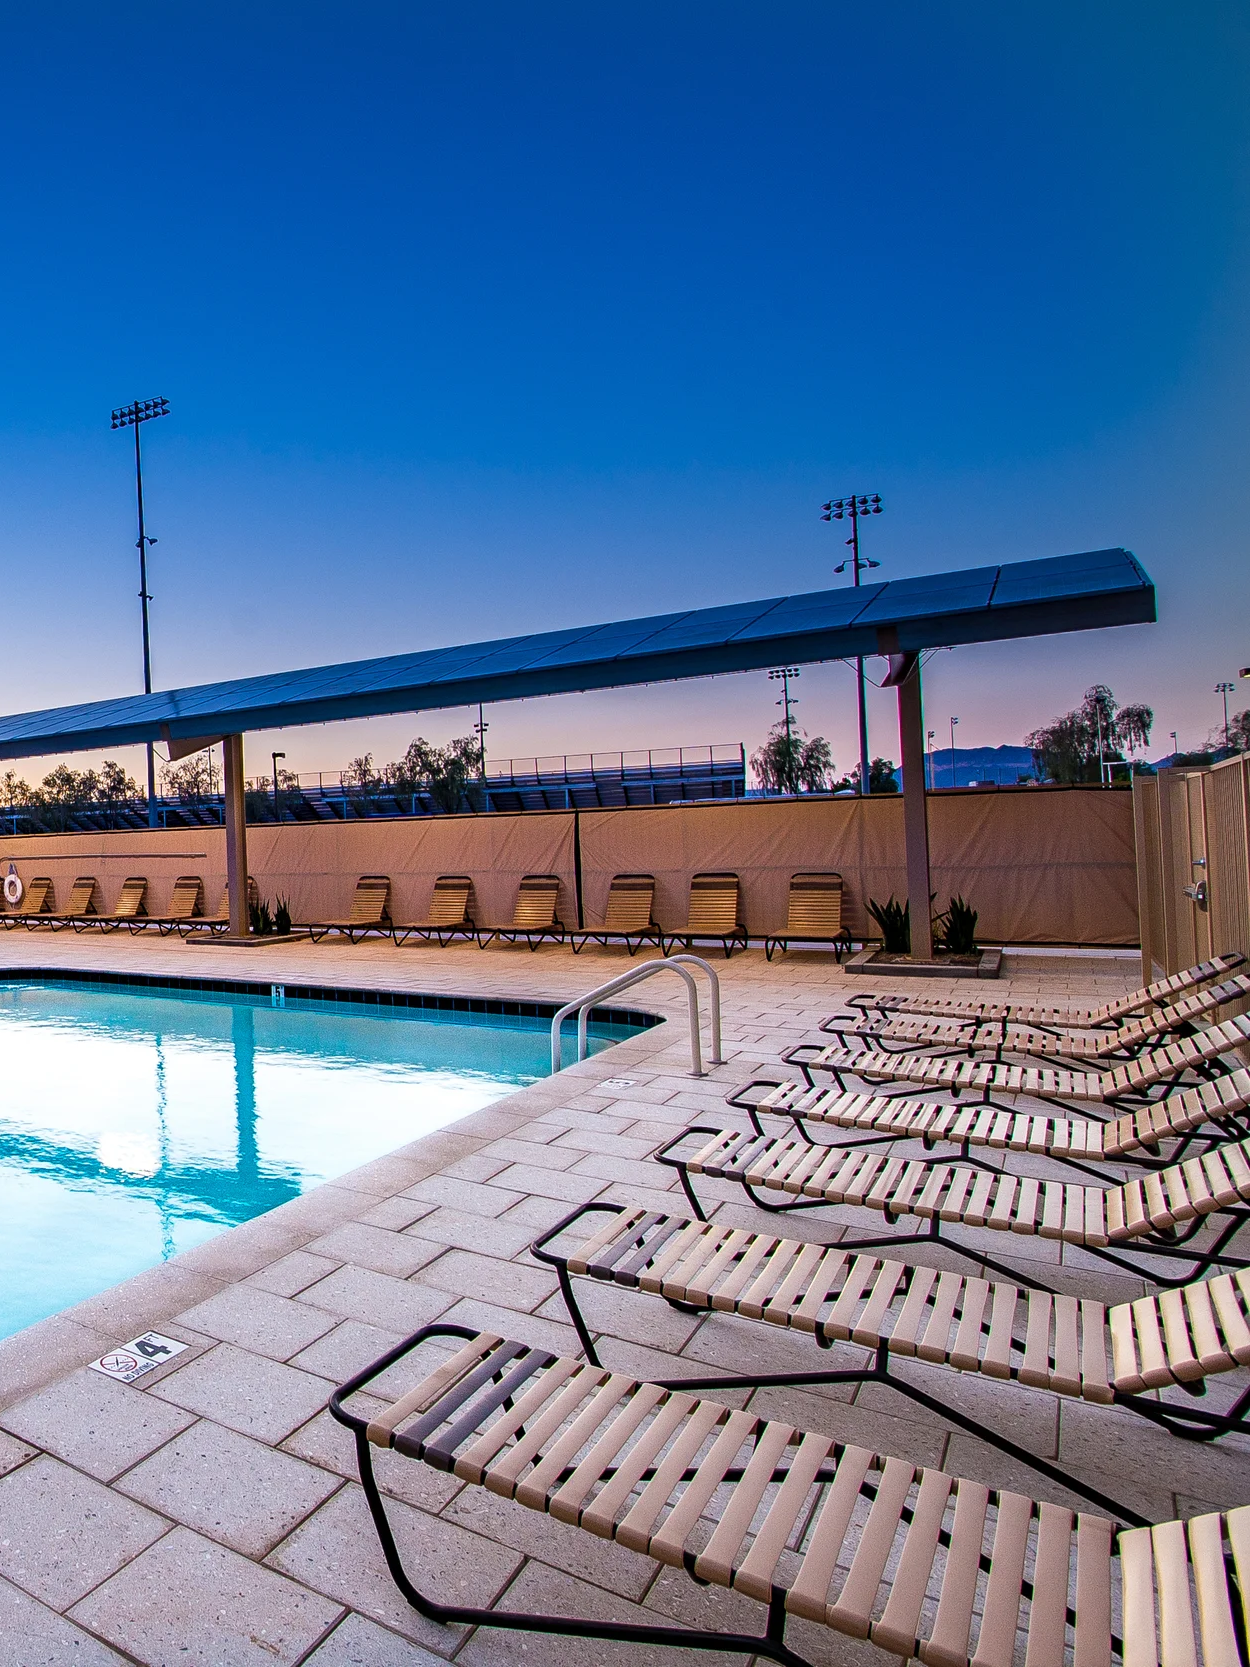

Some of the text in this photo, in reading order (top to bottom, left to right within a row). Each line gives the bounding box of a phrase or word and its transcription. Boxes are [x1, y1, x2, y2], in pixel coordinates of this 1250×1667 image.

[275, 985, 280, 996] 5
[134, 1334, 172, 1357] 4 FT
[122, 1371, 135, 1381] NO
[132, 1362, 155, 1376] DIVING
